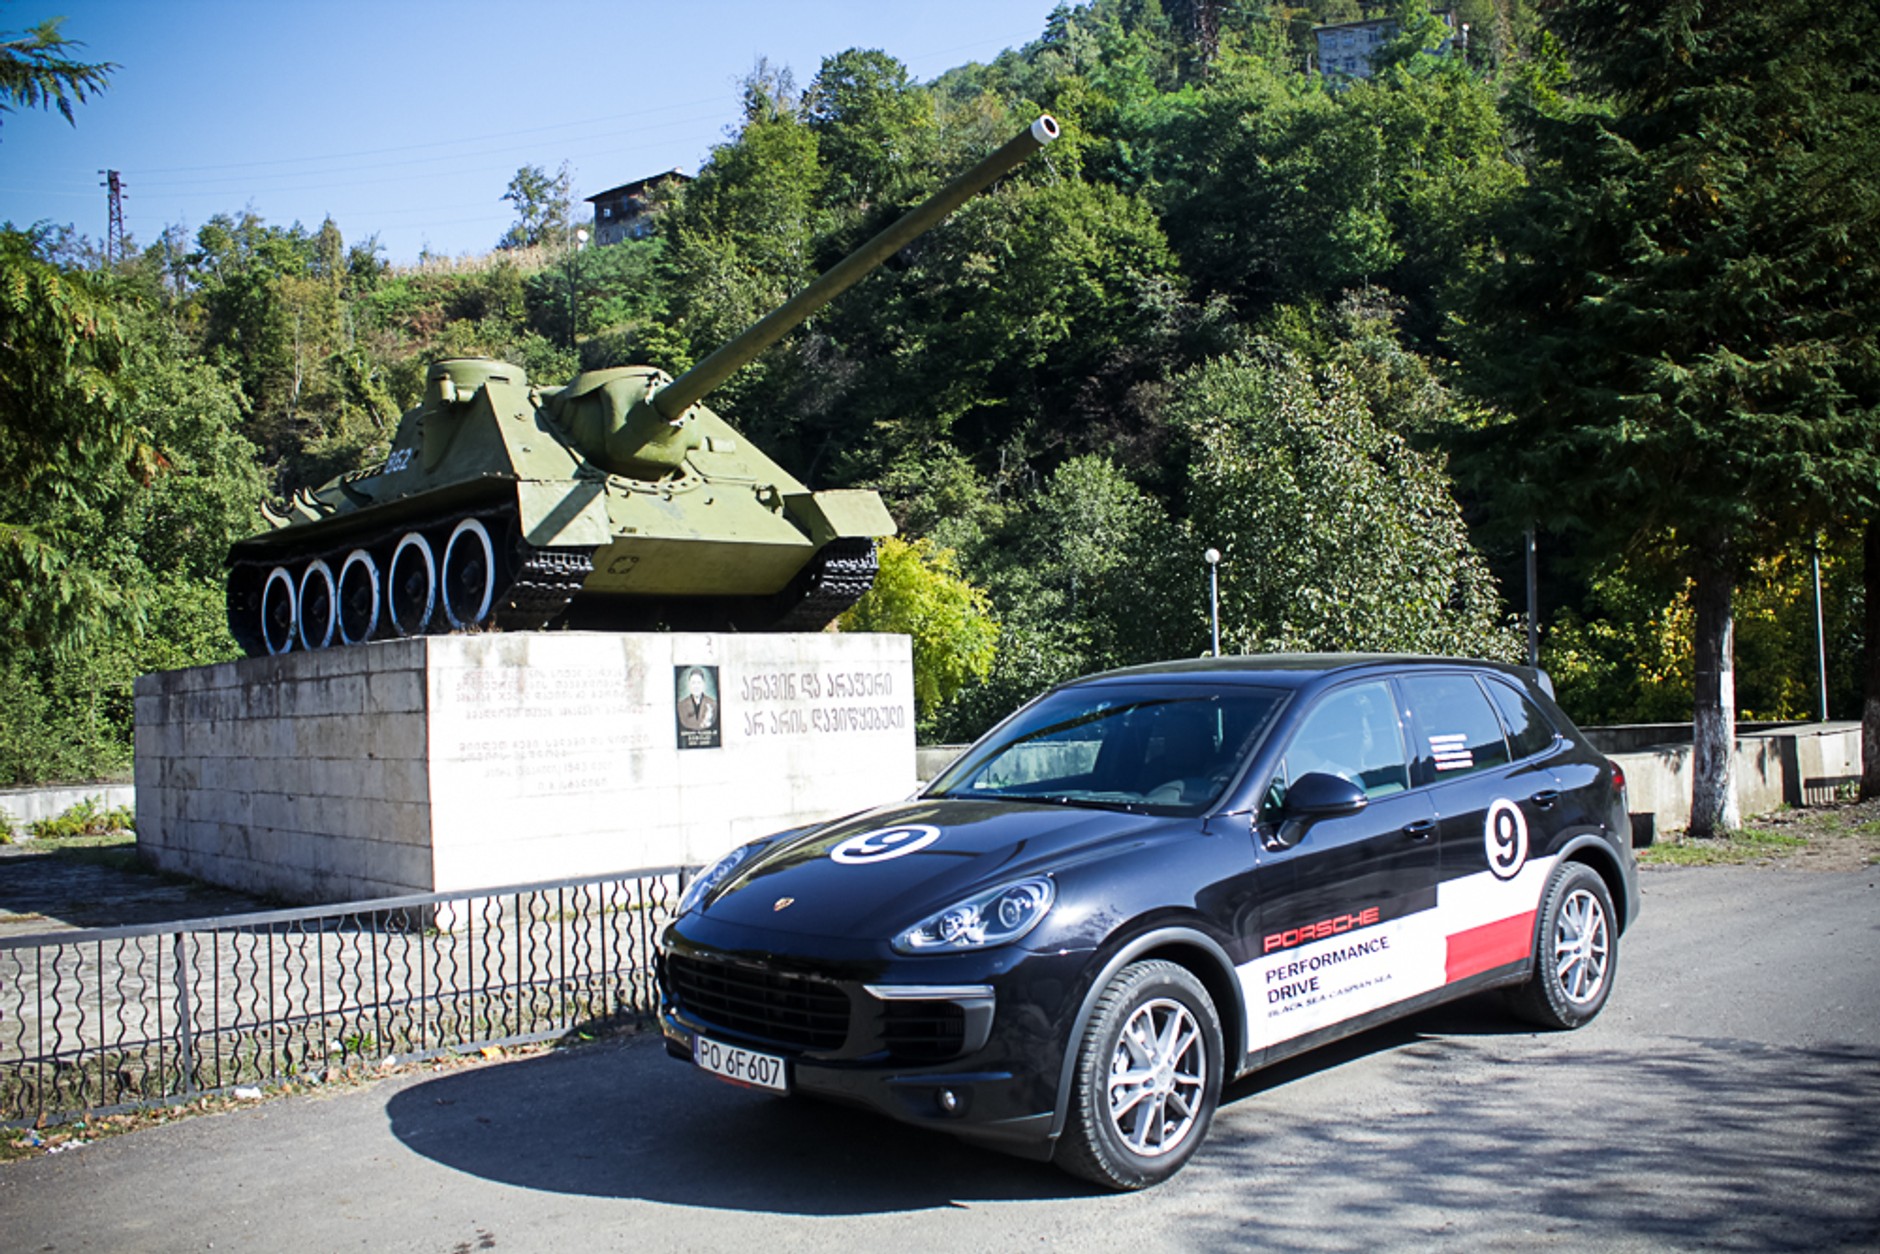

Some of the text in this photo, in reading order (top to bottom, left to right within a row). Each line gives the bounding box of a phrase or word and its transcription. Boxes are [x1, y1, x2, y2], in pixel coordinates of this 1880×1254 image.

[842, 828, 927, 857] 9
[1494, 807, 1518, 868] 9
[1263, 906, 1380, 953] PORSCHE
[1265, 936, 1390, 984] PERFORMANCE
[1267, 976, 1320, 1004] DRIVE
[701, 1040, 780, 1086] PO 6F607
